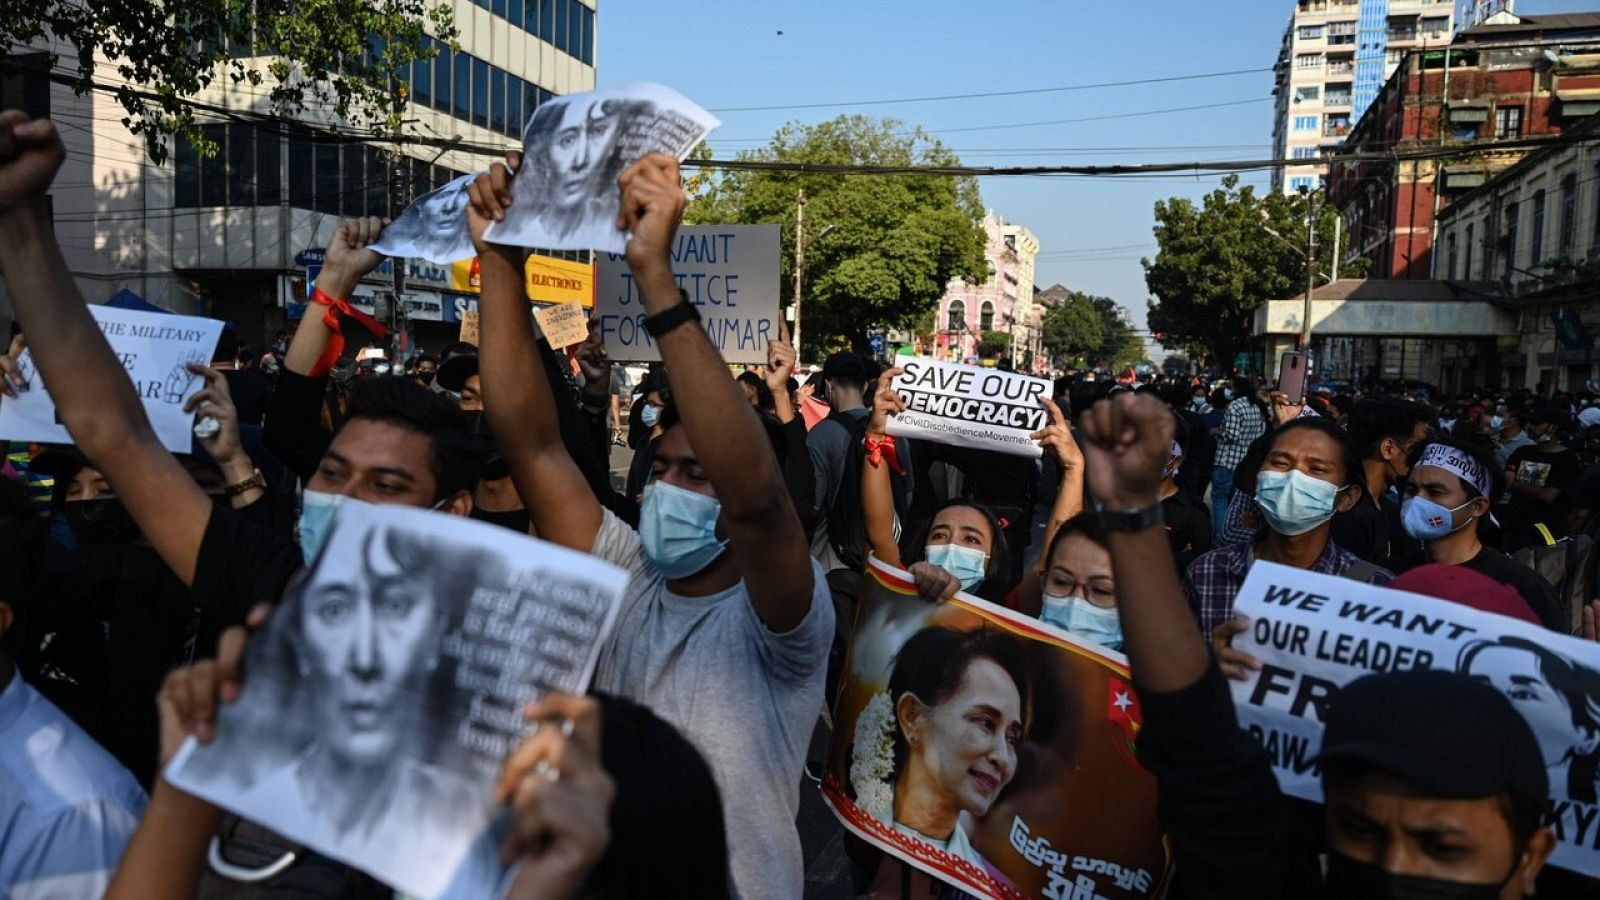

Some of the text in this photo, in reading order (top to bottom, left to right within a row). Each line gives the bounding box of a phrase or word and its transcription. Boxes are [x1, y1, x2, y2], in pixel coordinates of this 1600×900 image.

[531, 273, 583, 291] ELECTRONICS
[129, 323, 207, 343] MILITARY
[601, 314, 650, 346] FOR
[900, 362, 1046, 405] SAVE OUR
[896, 413, 1034, 446] #CivilDisobedienceMovemen
[1262, 584, 1478, 640] WE WANT
[1254, 616, 1311, 657] OUR
